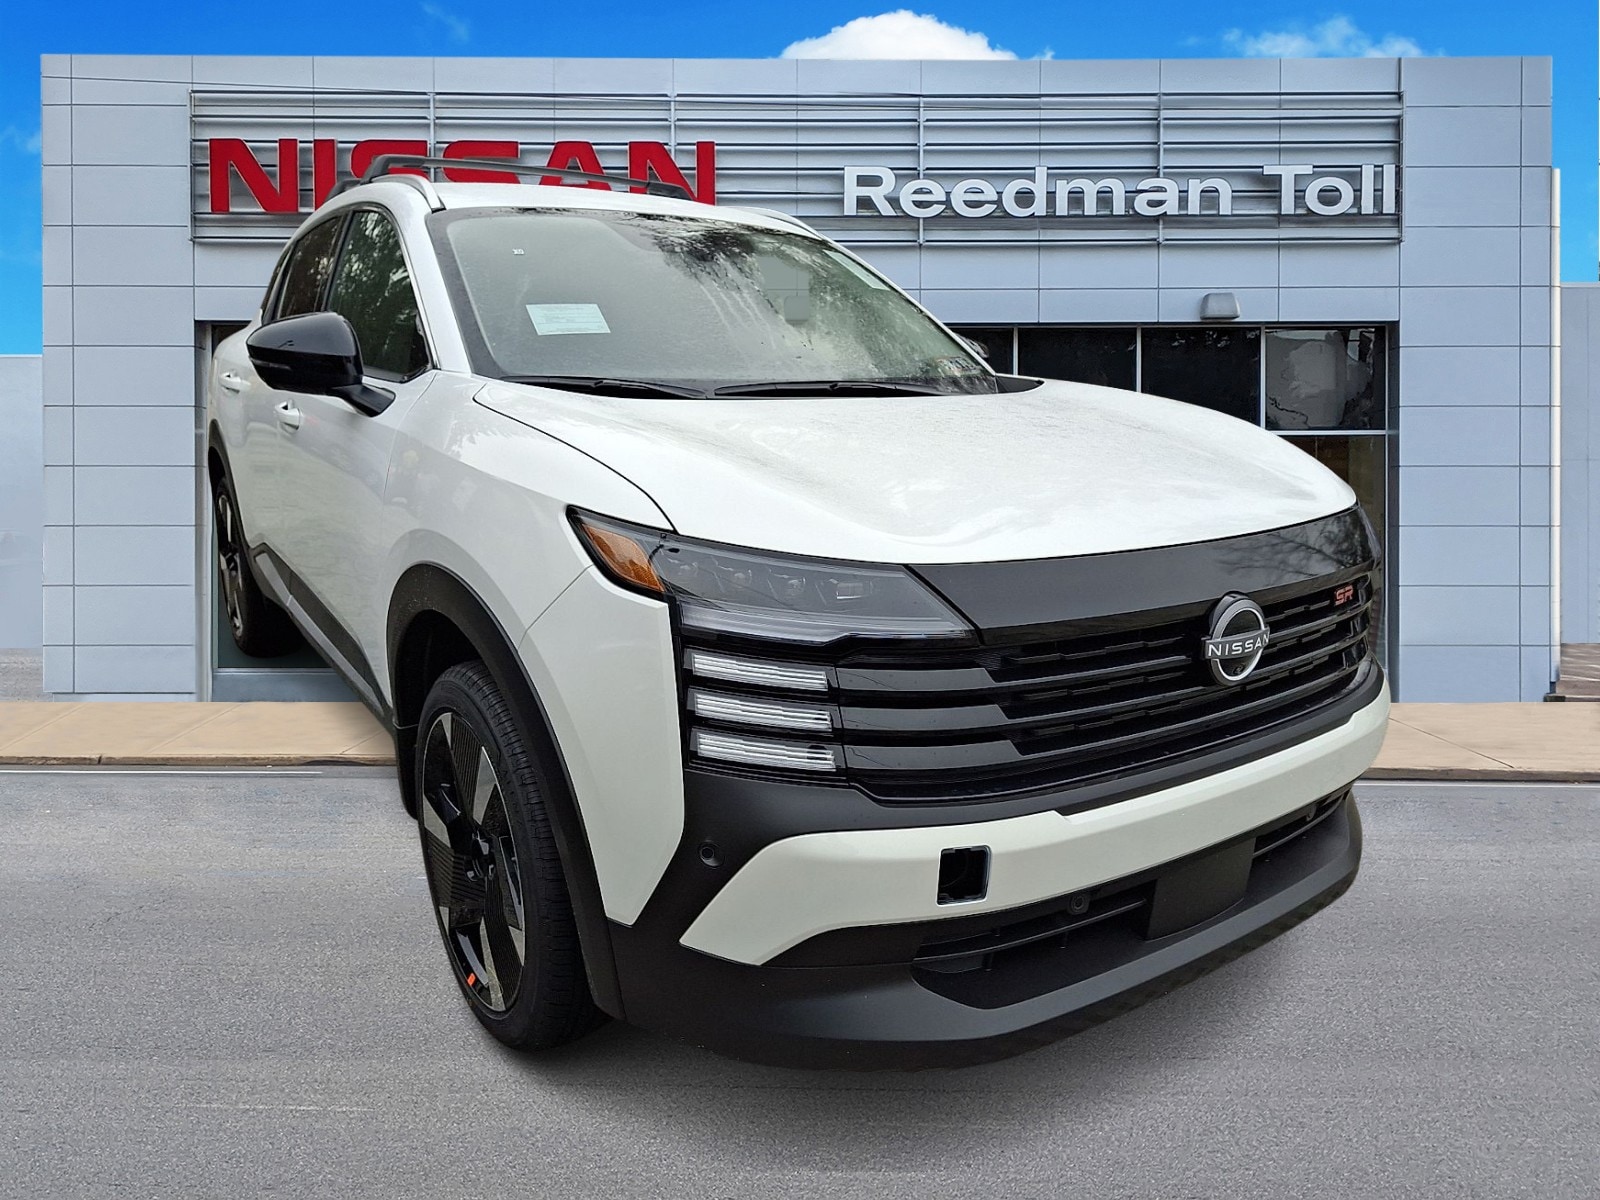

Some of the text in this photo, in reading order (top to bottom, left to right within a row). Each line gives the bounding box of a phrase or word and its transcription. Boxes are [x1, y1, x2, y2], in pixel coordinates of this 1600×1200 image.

[843, 164, 1396, 218] Reedman Toll
[1335, 585, 1354, 606] SR
[1208, 631, 1270, 657] NISSAN
